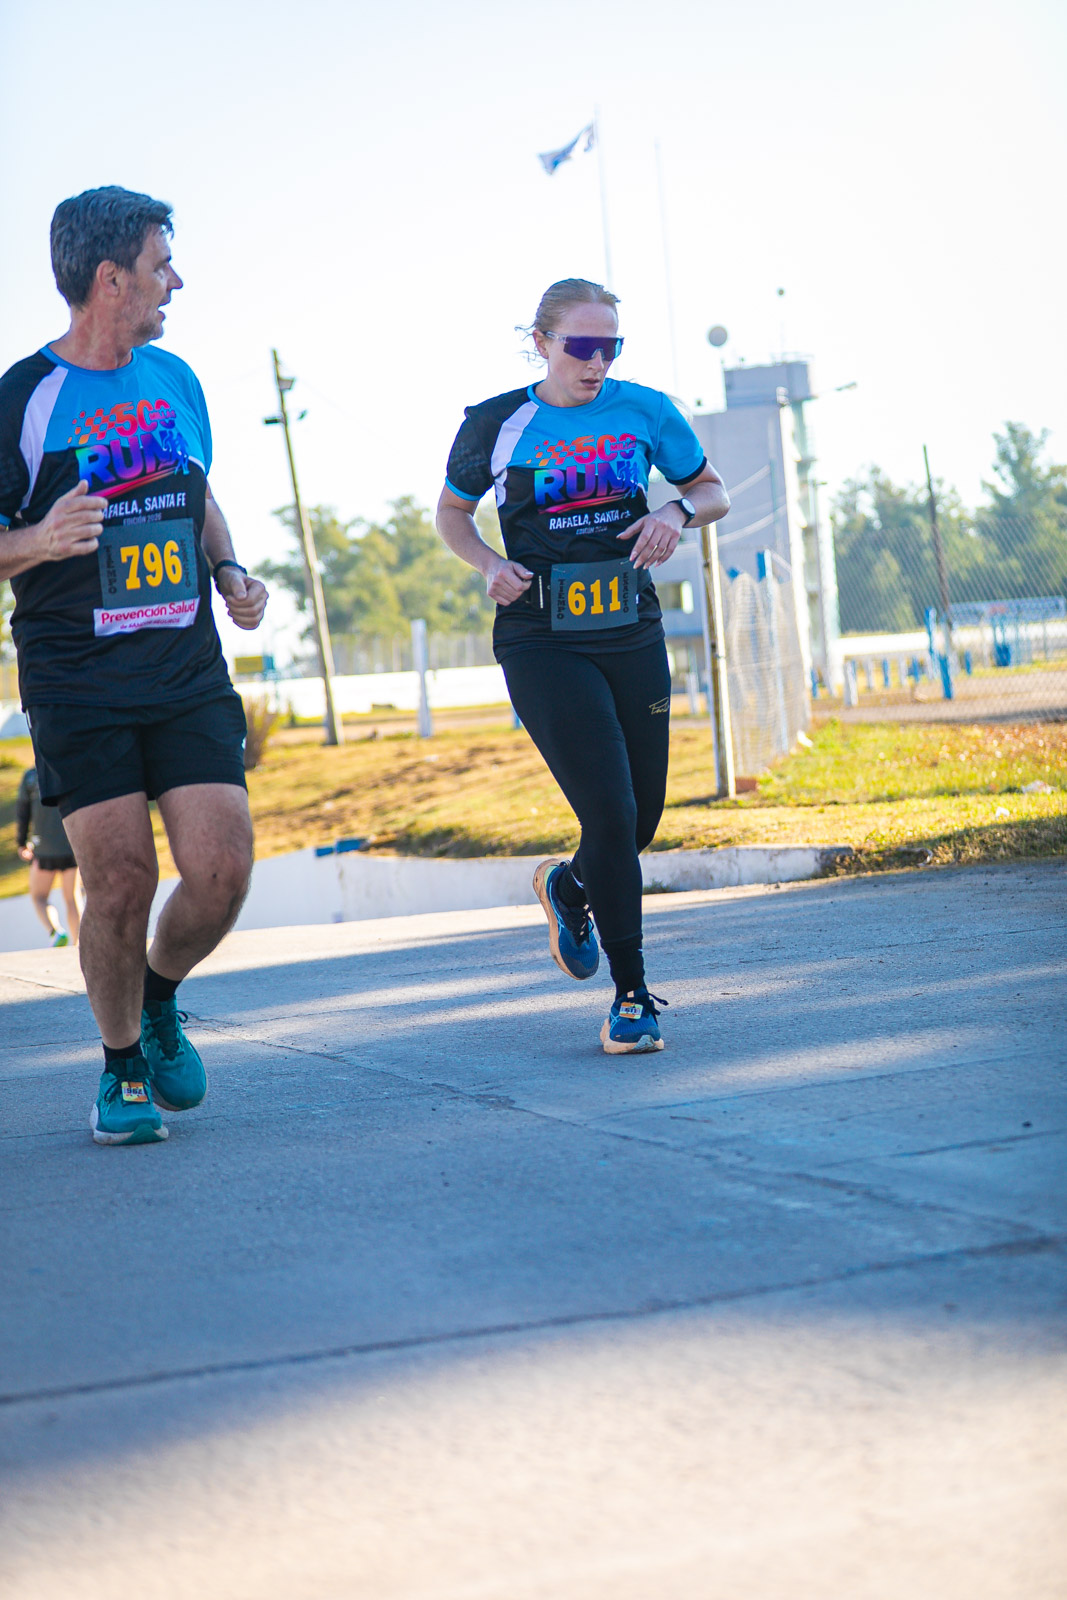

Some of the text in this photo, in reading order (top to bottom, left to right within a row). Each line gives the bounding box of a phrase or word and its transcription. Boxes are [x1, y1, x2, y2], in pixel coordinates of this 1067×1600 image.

[102, 492, 186, 519] AFAELA, SANTA FE
[549, 513, 591, 530] RAFAELA,
[120, 540, 182, 590] 796
[101, 600, 195, 624] Prevención Salud
[557, 579, 566, 620] TIEMPO
[567, 576, 621, 616] 611
